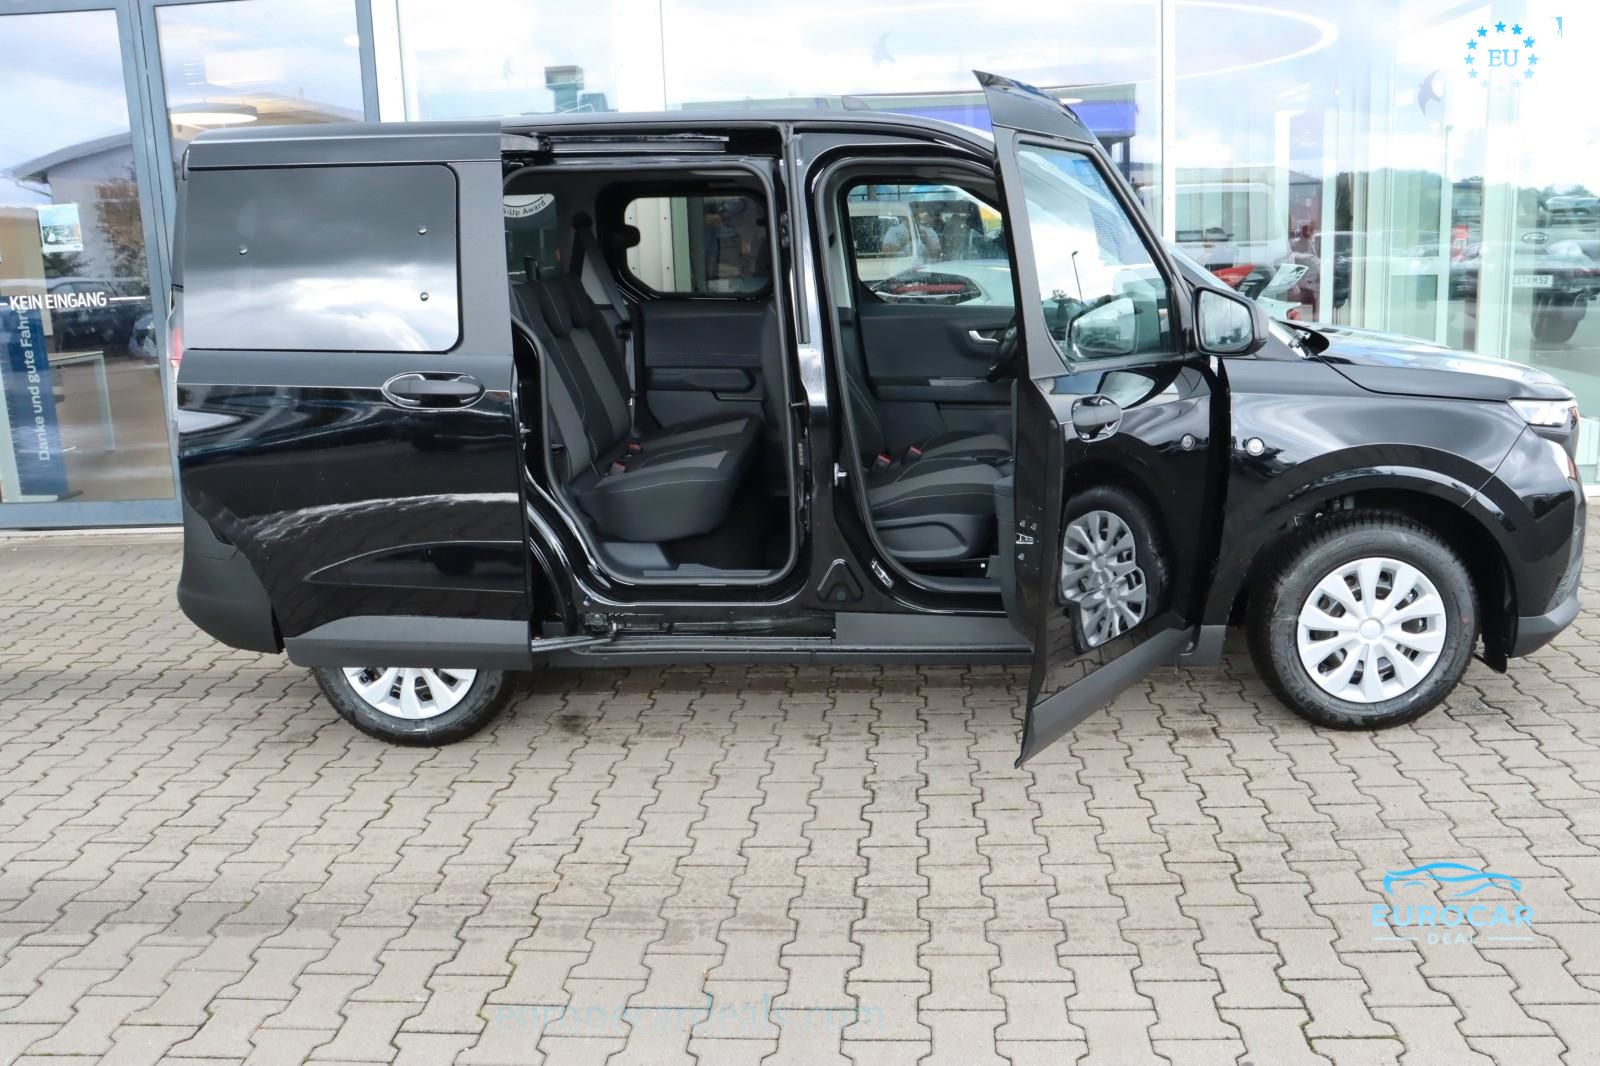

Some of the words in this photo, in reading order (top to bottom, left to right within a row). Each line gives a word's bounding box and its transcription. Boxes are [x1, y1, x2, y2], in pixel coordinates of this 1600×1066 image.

[522, 199, 547, 216] Award
[9, 294, 43, 311] KEIN
[45, 291, 107, 310] EINGANG
[23, 349, 41, 384] gute
[27, 386, 43, 414] und
[34, 415, 51, 461] Danke
